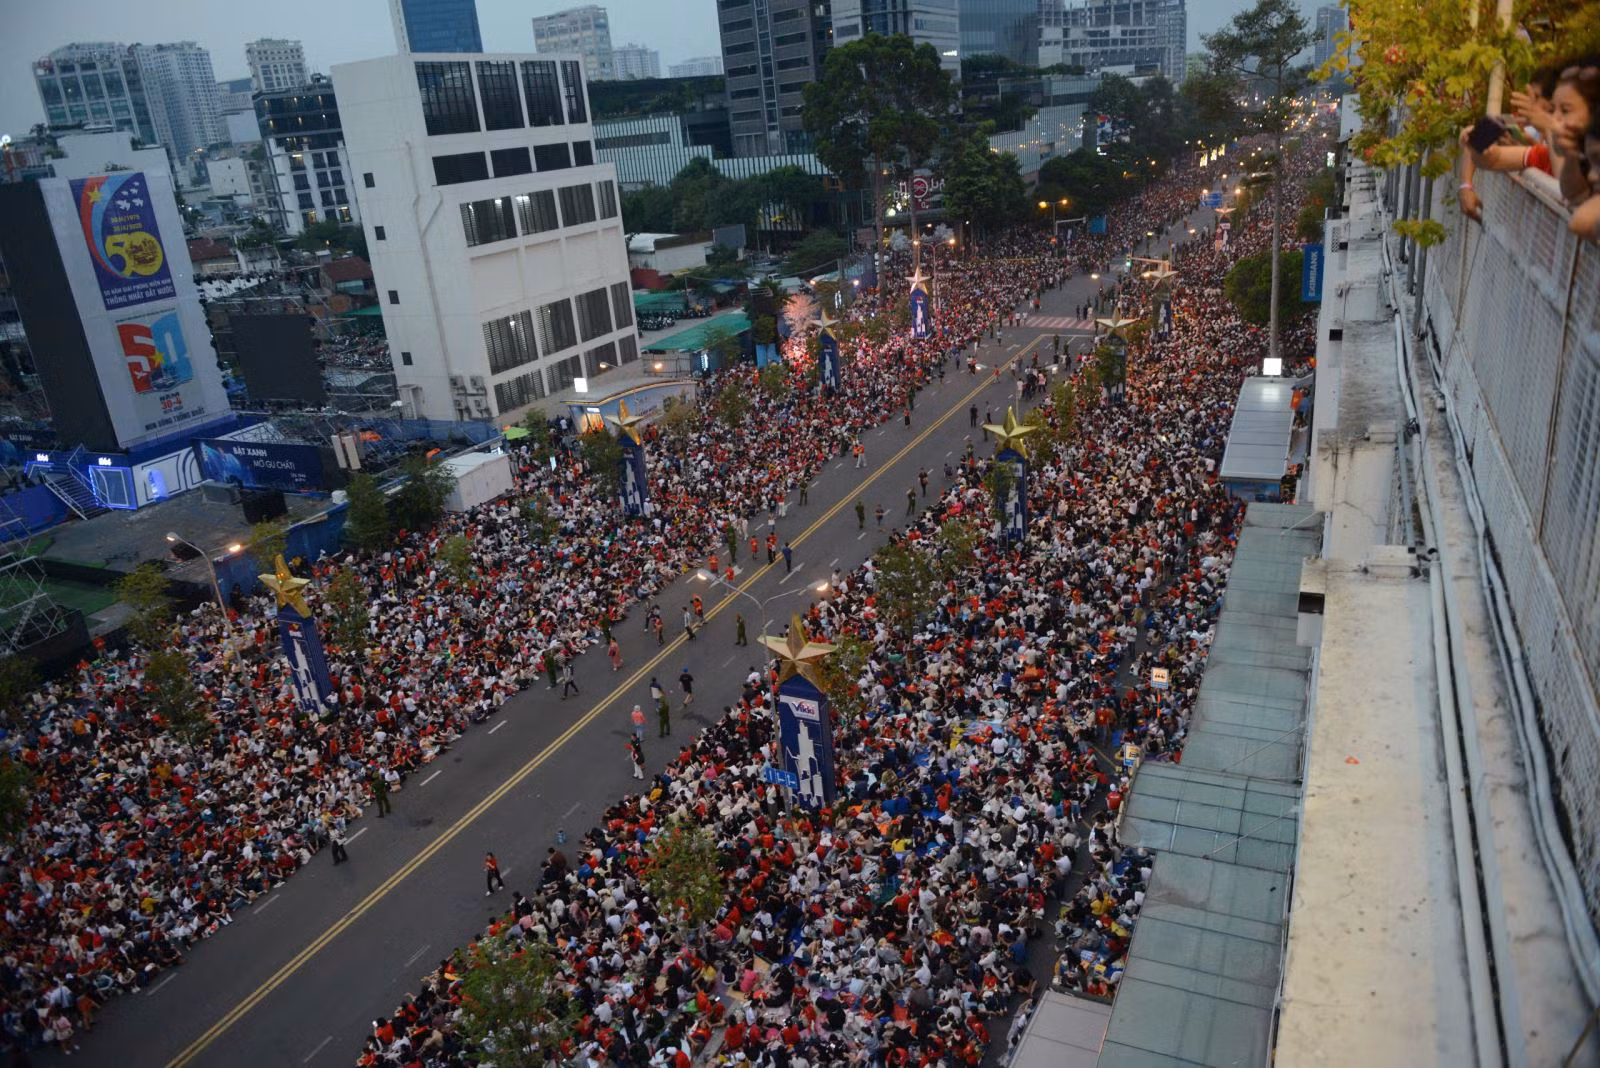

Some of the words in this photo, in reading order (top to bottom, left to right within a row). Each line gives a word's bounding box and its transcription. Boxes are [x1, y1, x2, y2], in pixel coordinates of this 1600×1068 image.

[105, 231, 163, 276] 50
[1308, 251, 1318, 297] EXIMBANK
[246, 447, 268, 457] XANH
